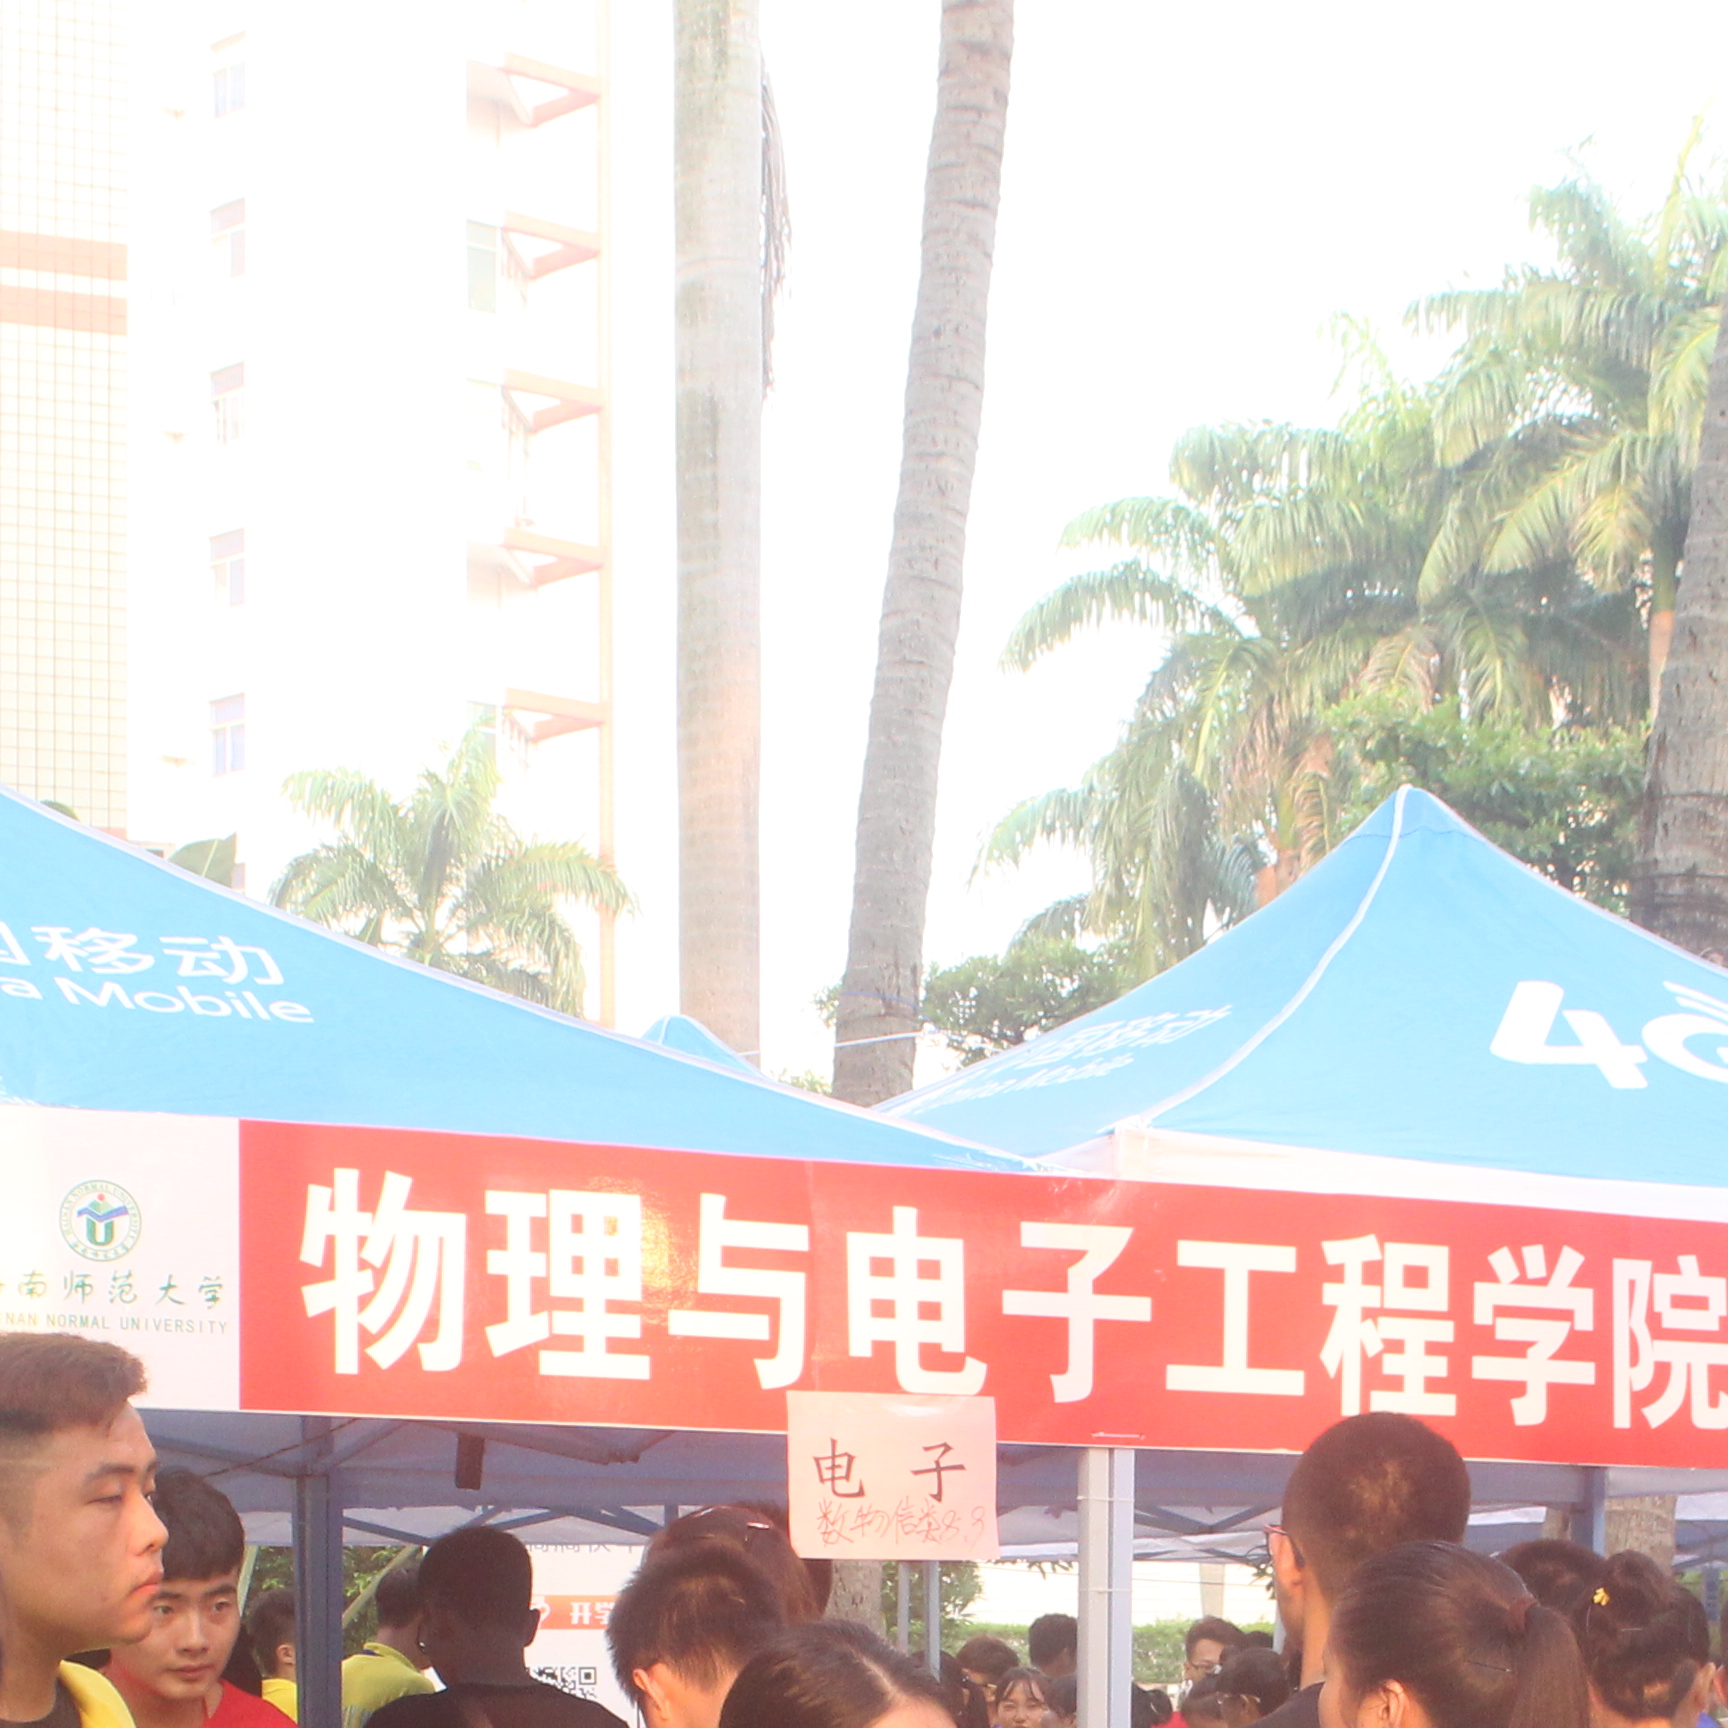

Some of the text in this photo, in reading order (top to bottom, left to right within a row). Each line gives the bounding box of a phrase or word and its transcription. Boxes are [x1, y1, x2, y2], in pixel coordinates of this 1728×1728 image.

[53, 976, 315, 1024] Mobile
[46, 1313, 110, 1330] NORMAL
[119, 1317, 228, 1335] UNIVERSITY
[812, 1436, 967, 1503] 电子
